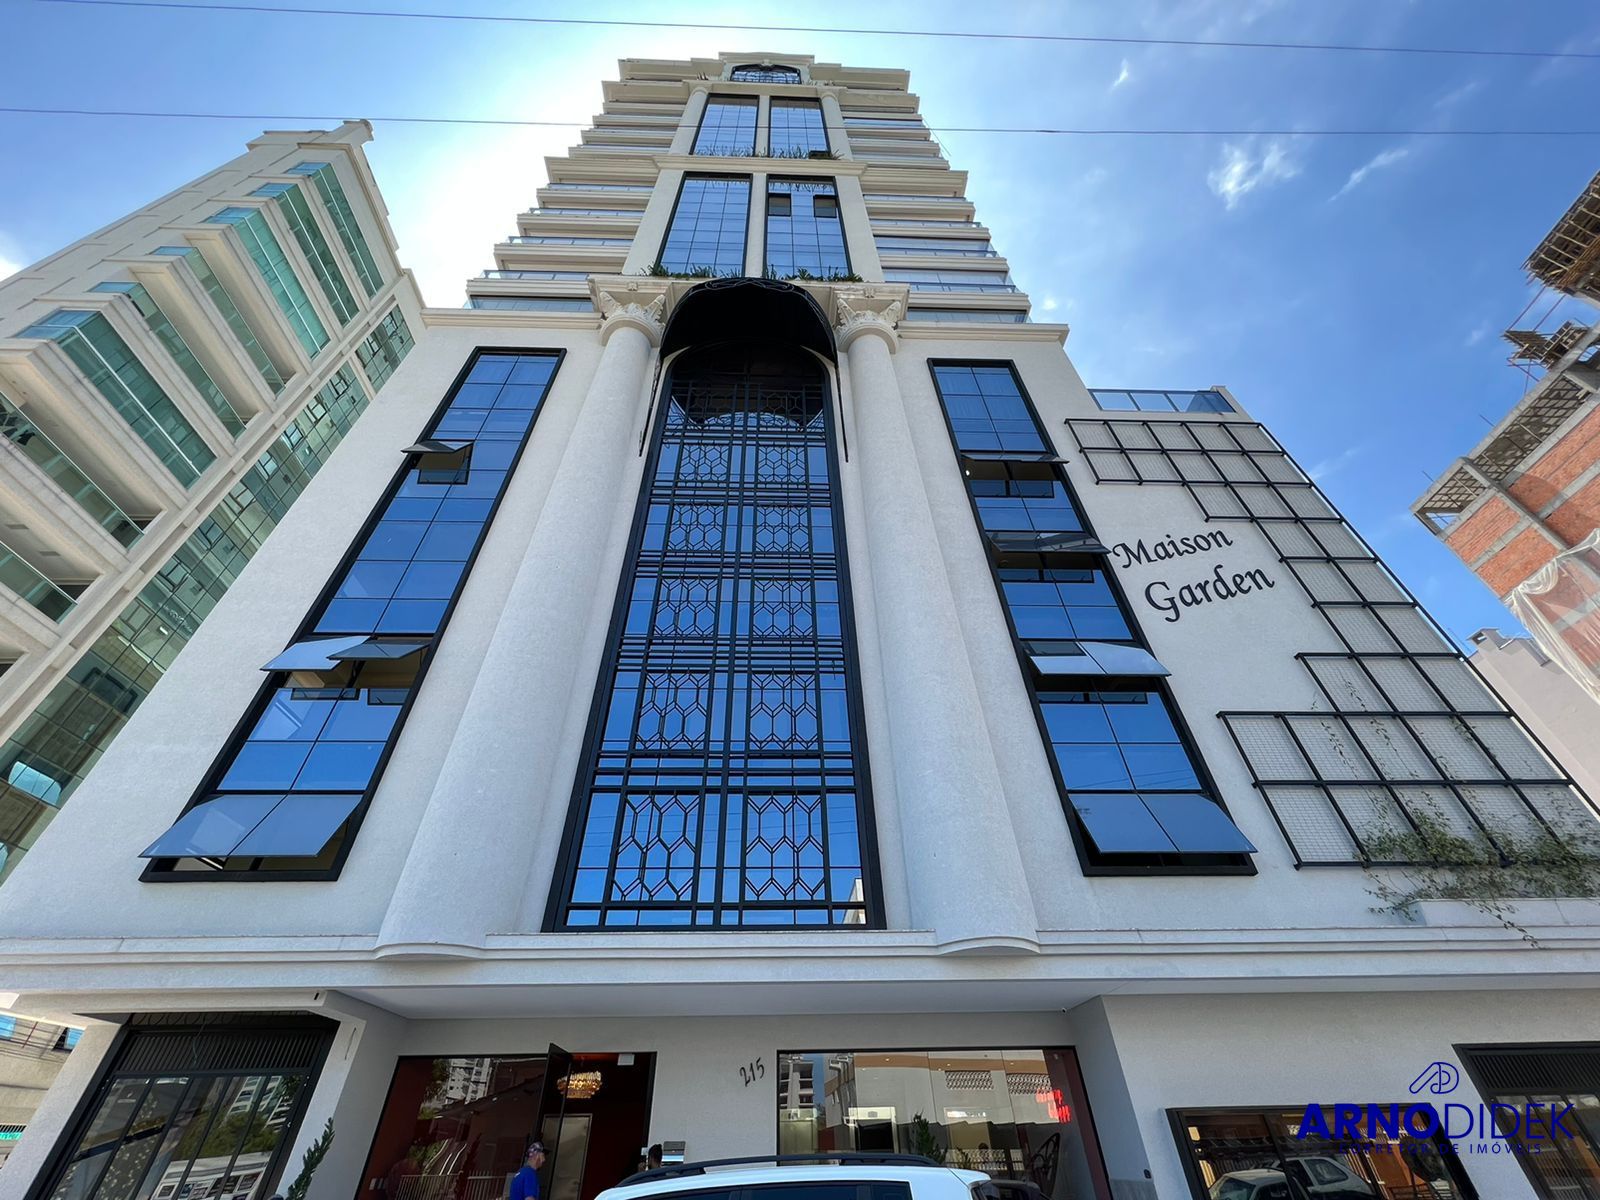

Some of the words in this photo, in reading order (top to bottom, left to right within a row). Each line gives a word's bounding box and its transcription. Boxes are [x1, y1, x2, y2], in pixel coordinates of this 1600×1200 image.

[1113, 530, 1233, 568] Maison
[1145, 565, 1275, 622] Garden
[740, 1057, 764, 1087] 215
